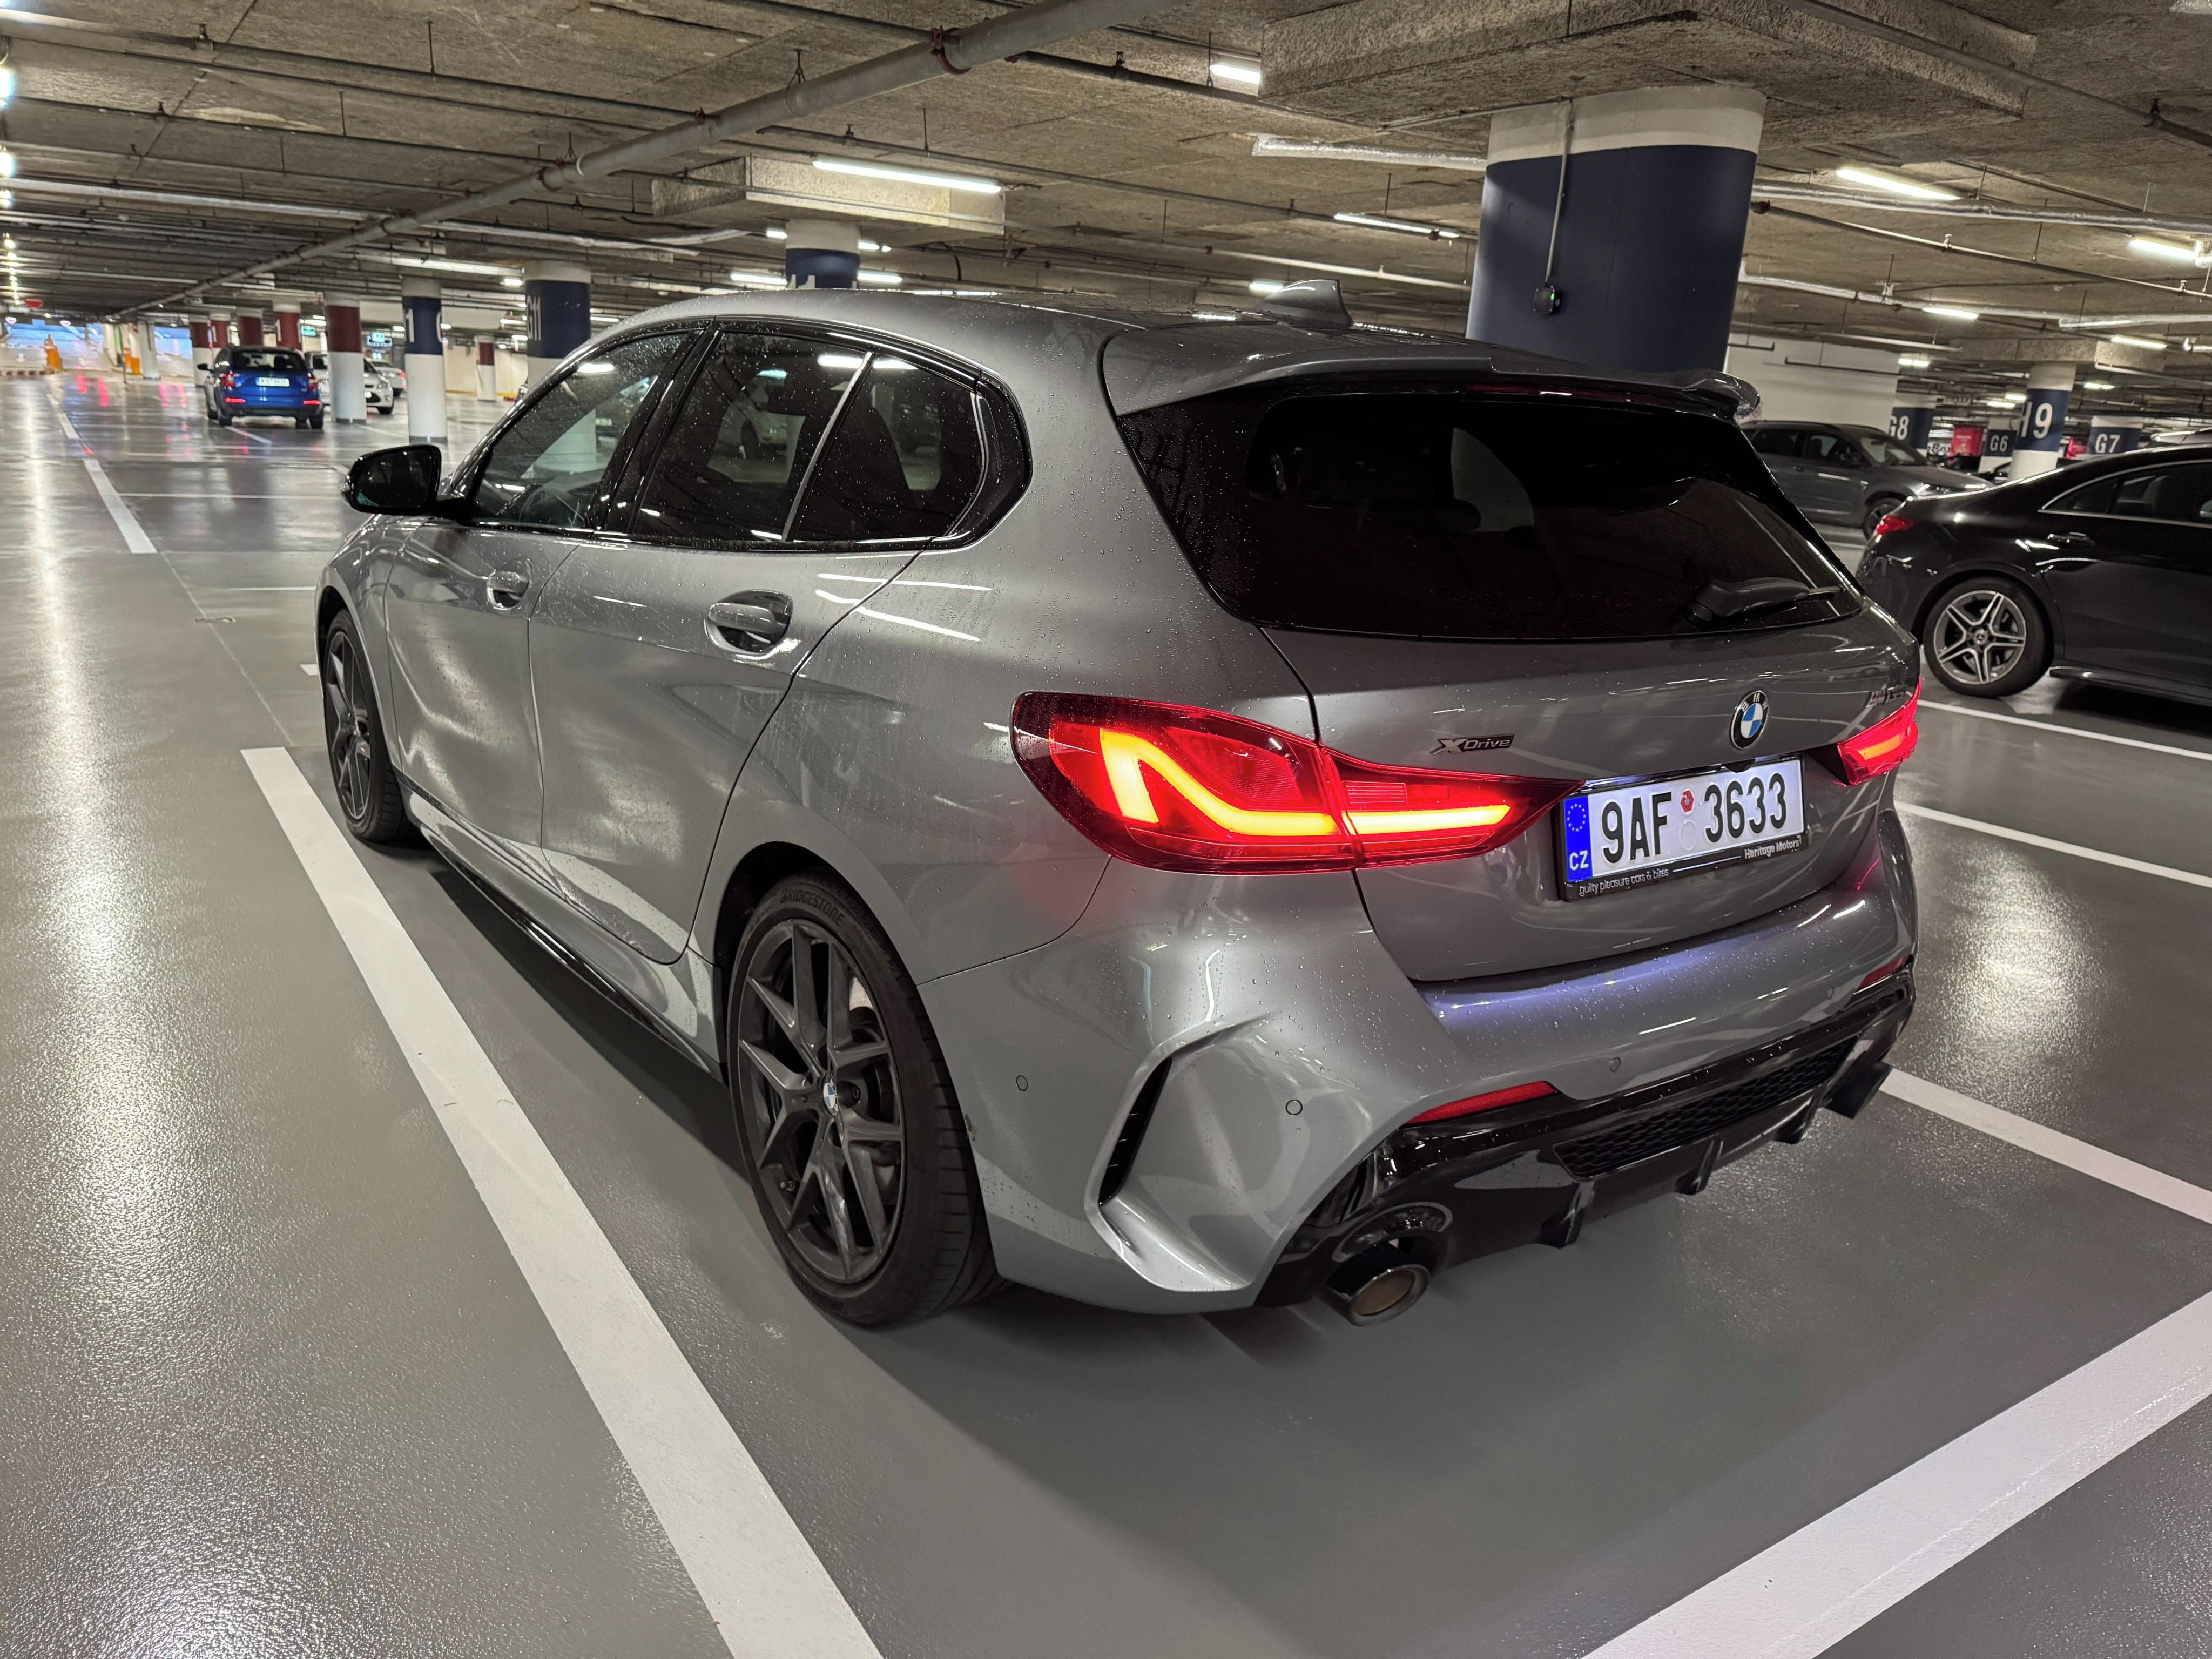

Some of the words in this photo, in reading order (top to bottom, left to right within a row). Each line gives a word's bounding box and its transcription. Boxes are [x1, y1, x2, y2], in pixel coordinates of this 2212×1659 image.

[1990, 435, 2008, 452] G6
[2095, 433, 2121, 454] G7
[1601, 791, 1672, 864] 9AF
[1703, 773, 1786, 843] 3633
[1744, 846, 1775, 859] Heritage
[1776, 840, 1799, 852] Motors
[1569, 850, 1589, 871] CZ
[1579, 882, 1599, 897] guilty
[1600, 877, 1630, 893] pleasure
[1646, 871, 1653, 880] &
[1653, 868, 1670, 879] bikes
[780, 888, 846, 926] BRIDGESTONE
